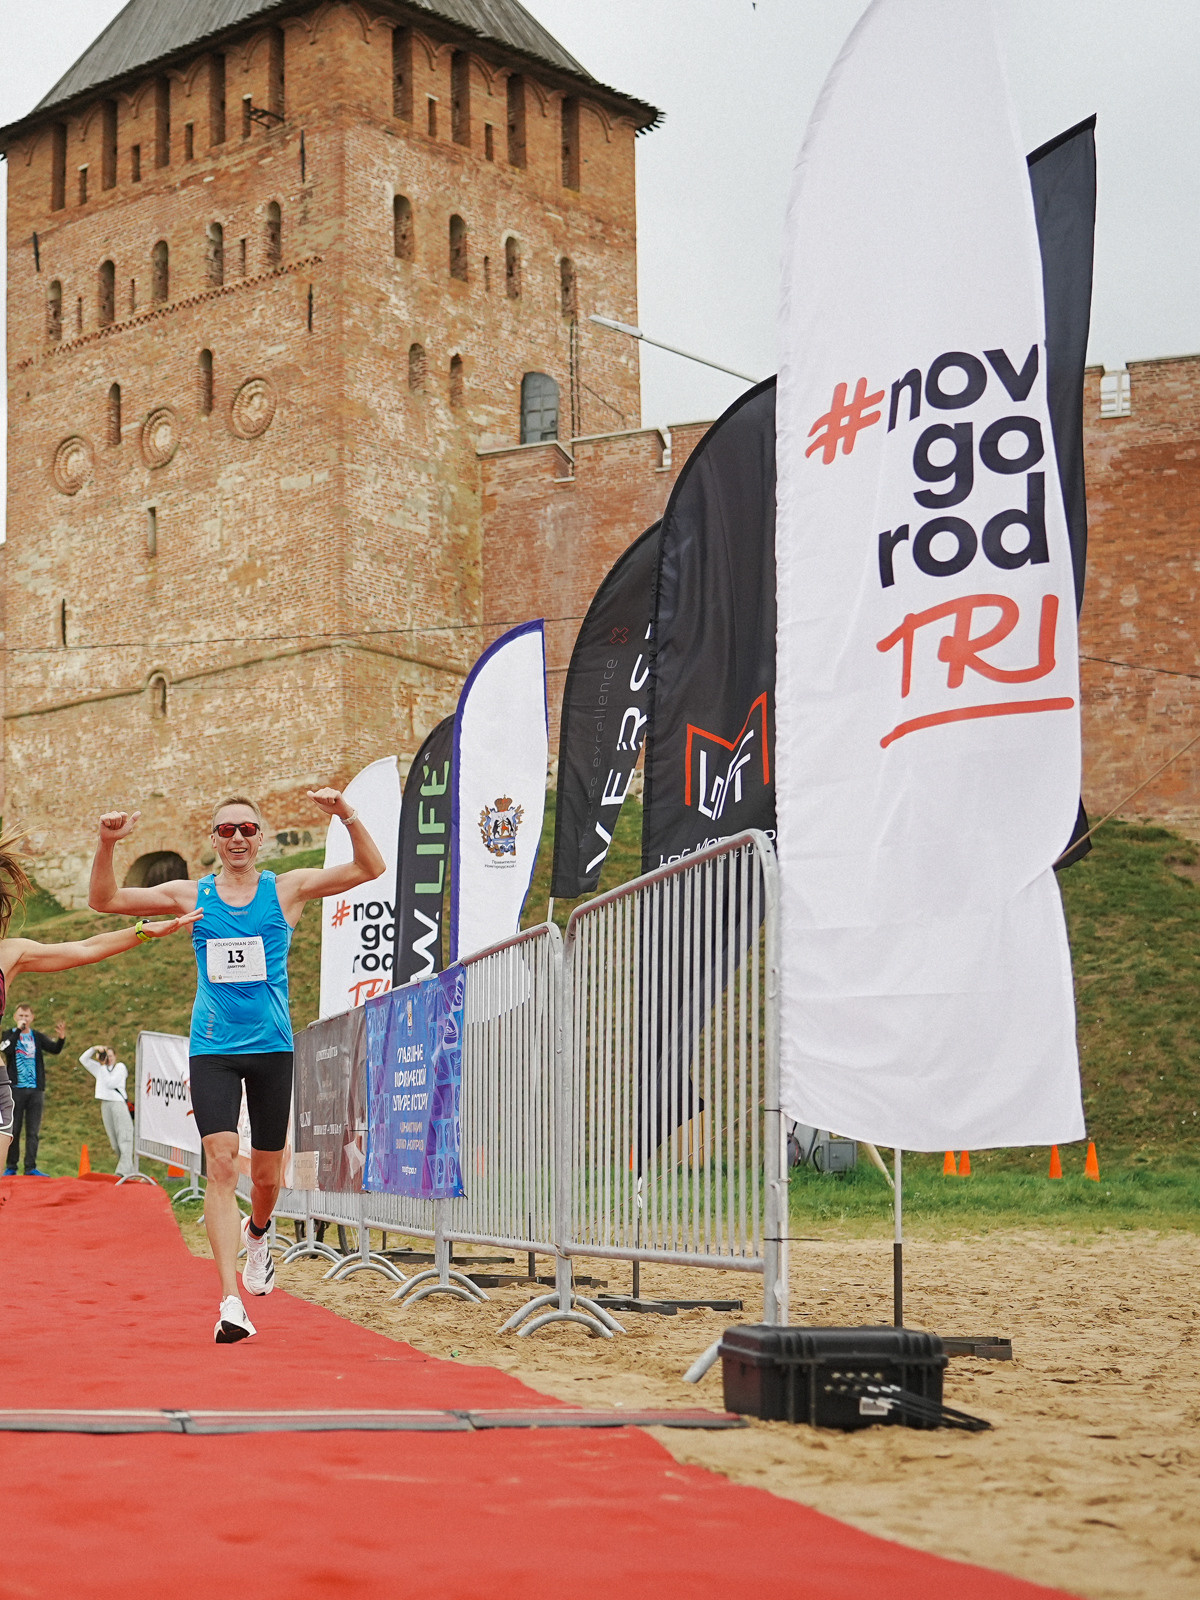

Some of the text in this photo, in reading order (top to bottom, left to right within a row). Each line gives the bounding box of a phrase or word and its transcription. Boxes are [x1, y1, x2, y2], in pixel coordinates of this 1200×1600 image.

[803, 342, 1043, 465] #nov
[911, 414, 1047, 510] go
[878, 470, 1050, 589] rod
[876, 592, 1060, 699] TRI
[227, 949, 245, 964] 13
